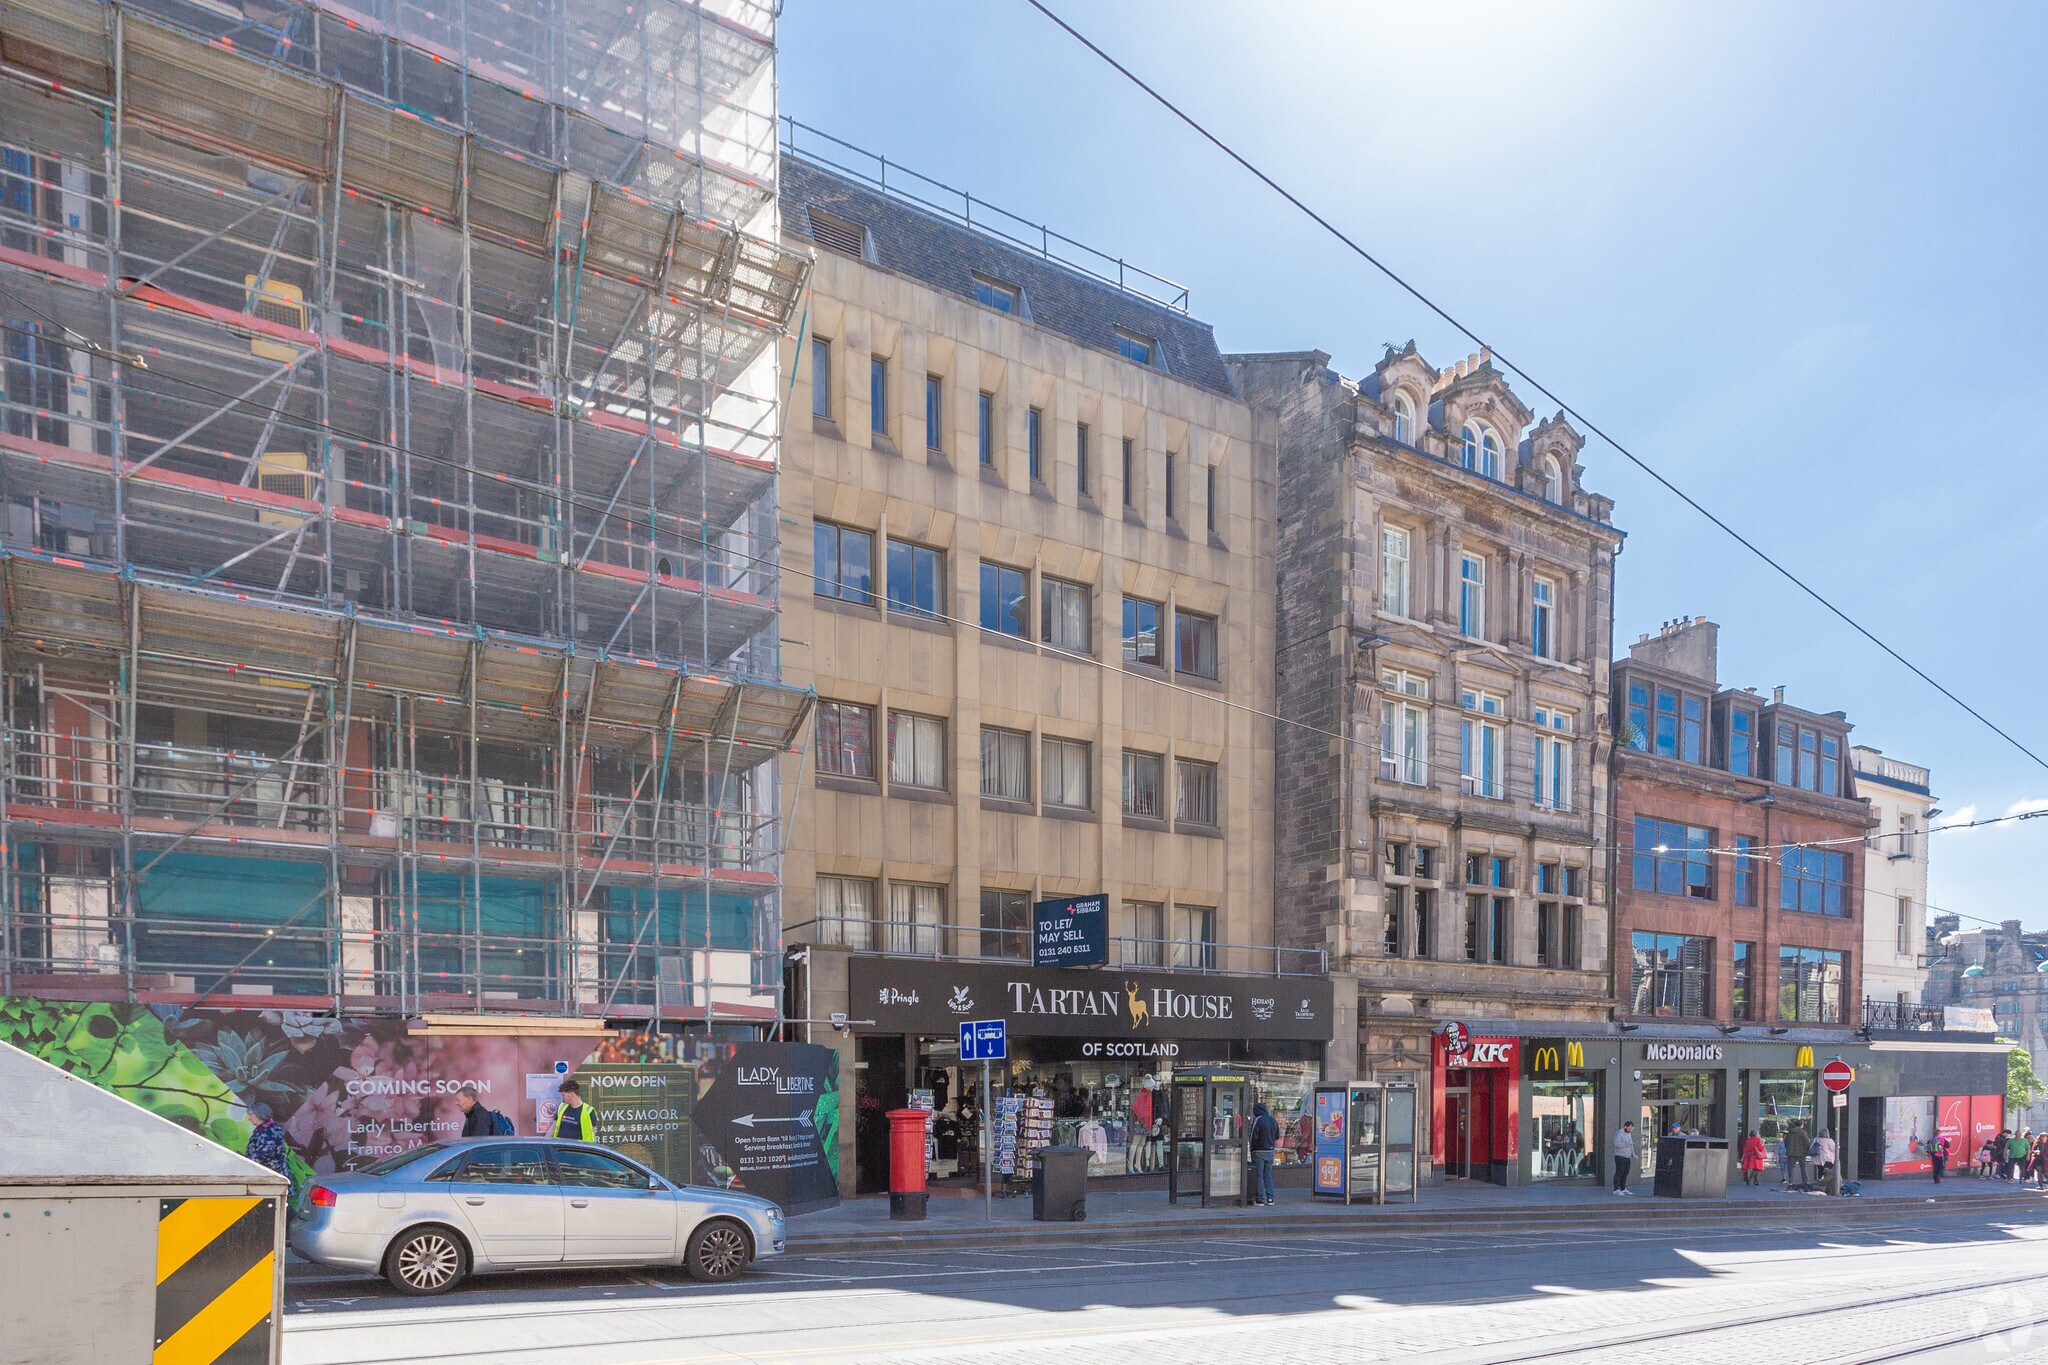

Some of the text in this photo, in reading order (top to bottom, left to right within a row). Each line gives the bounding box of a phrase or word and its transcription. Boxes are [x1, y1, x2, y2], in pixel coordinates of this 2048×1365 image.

[1076, 900, 1100, 908] GRAHAM
[1076, 906, 1100, 914] SIBBALD
[1040, 918, 1073, 932] TO LET/
[1040, 930, 1084, 944] MAY SELL
[1039, 944, 1090, 956] 0131 240 5311
[890, 987, 920, 1006] Pringle
[1008, 982, 1233, 1020] TARTAN HOUSE
[1082, 1043, 1179, 1056] OF SCOTLAND
[1472, 1044, 1513, 1062] KFC
[1646, 1044, 1723, 1060] McDonald's
[346, 1079, 430, 1094] COMING
[591, 1076, 666, 1088] NOW OPEN
[597, 1109, 678, 1121] WKSMOOR
[348, 1118, 459, 1138] Lady Libertine
[630, 1123, 678, 1132] SEAFOOD
[595, 1134, 664, 1143] RESTAURANT
[735, 1136, 751, 1145] Open
[348, 1140, 402, 1155] Franco
